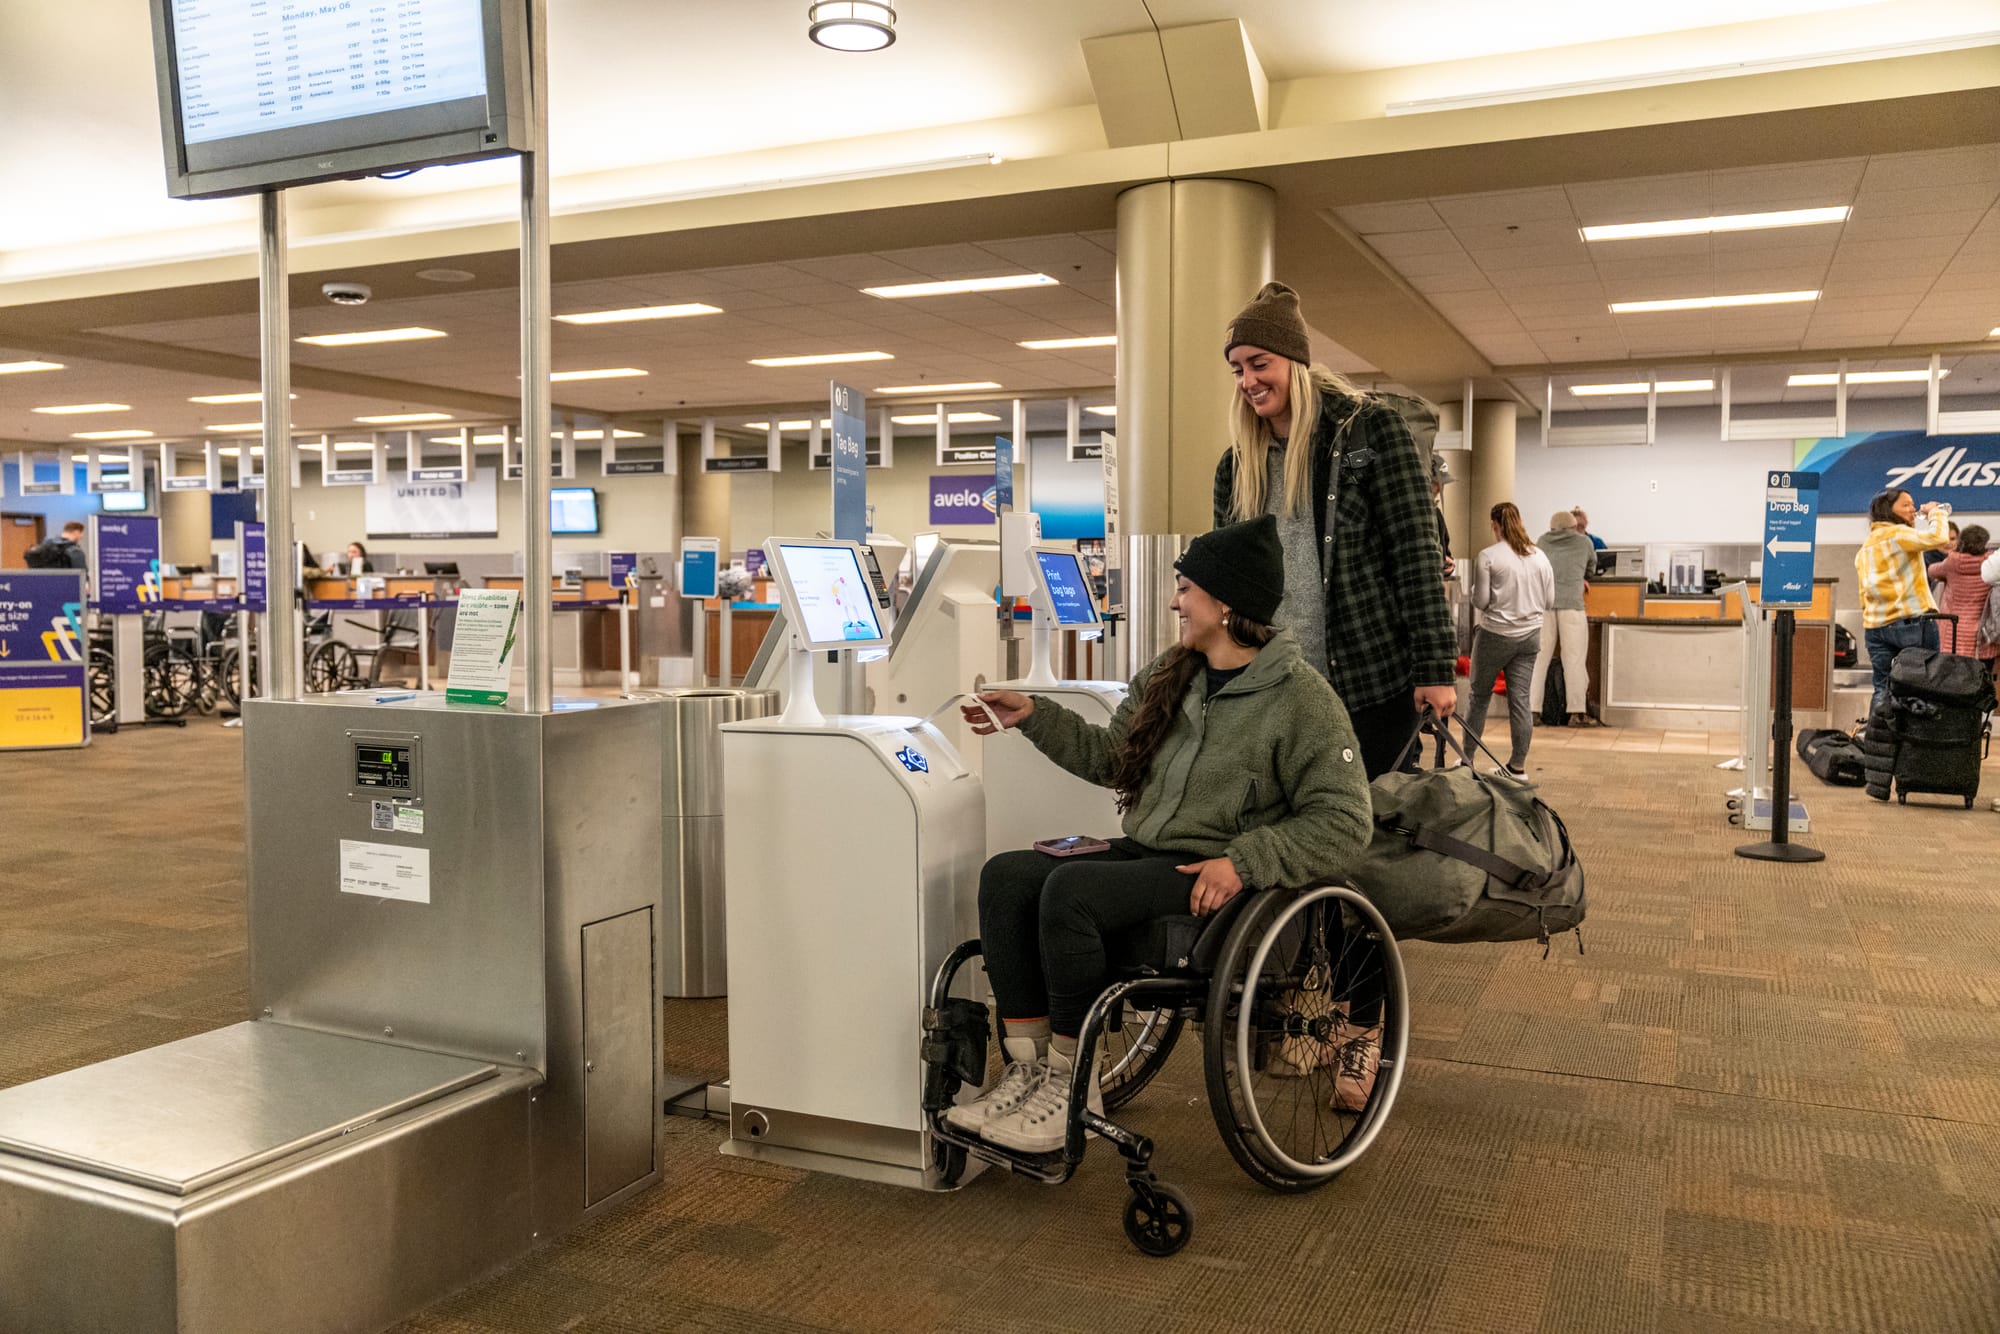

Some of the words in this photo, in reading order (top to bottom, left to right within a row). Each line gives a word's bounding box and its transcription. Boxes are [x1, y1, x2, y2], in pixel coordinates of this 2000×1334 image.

[282, 9, 317, 22] Monday,
[320, 6, 336, 15] May
[318, 161, 334, 169] NEC
[836, 432, 847, 455] Tag
[848, 436, 858, 459] Bag
[954, 452, 979, 460] Position
[1885, 446, 2000, 488] Alas
[398, 487, 446, 497] UNITED
[934, 489, 980, 507] avelo
[1770, 502, 1791, 513] Drop
[1793, 502, 1809, 514] Bag
[1046, 569, 1062, 581] Print
[248, 579, 261, 587] bag
[1051, 584, 1064, 597] bag
[1063, 585, 1076, 597] tags
[8, 611, 29, 620] size
